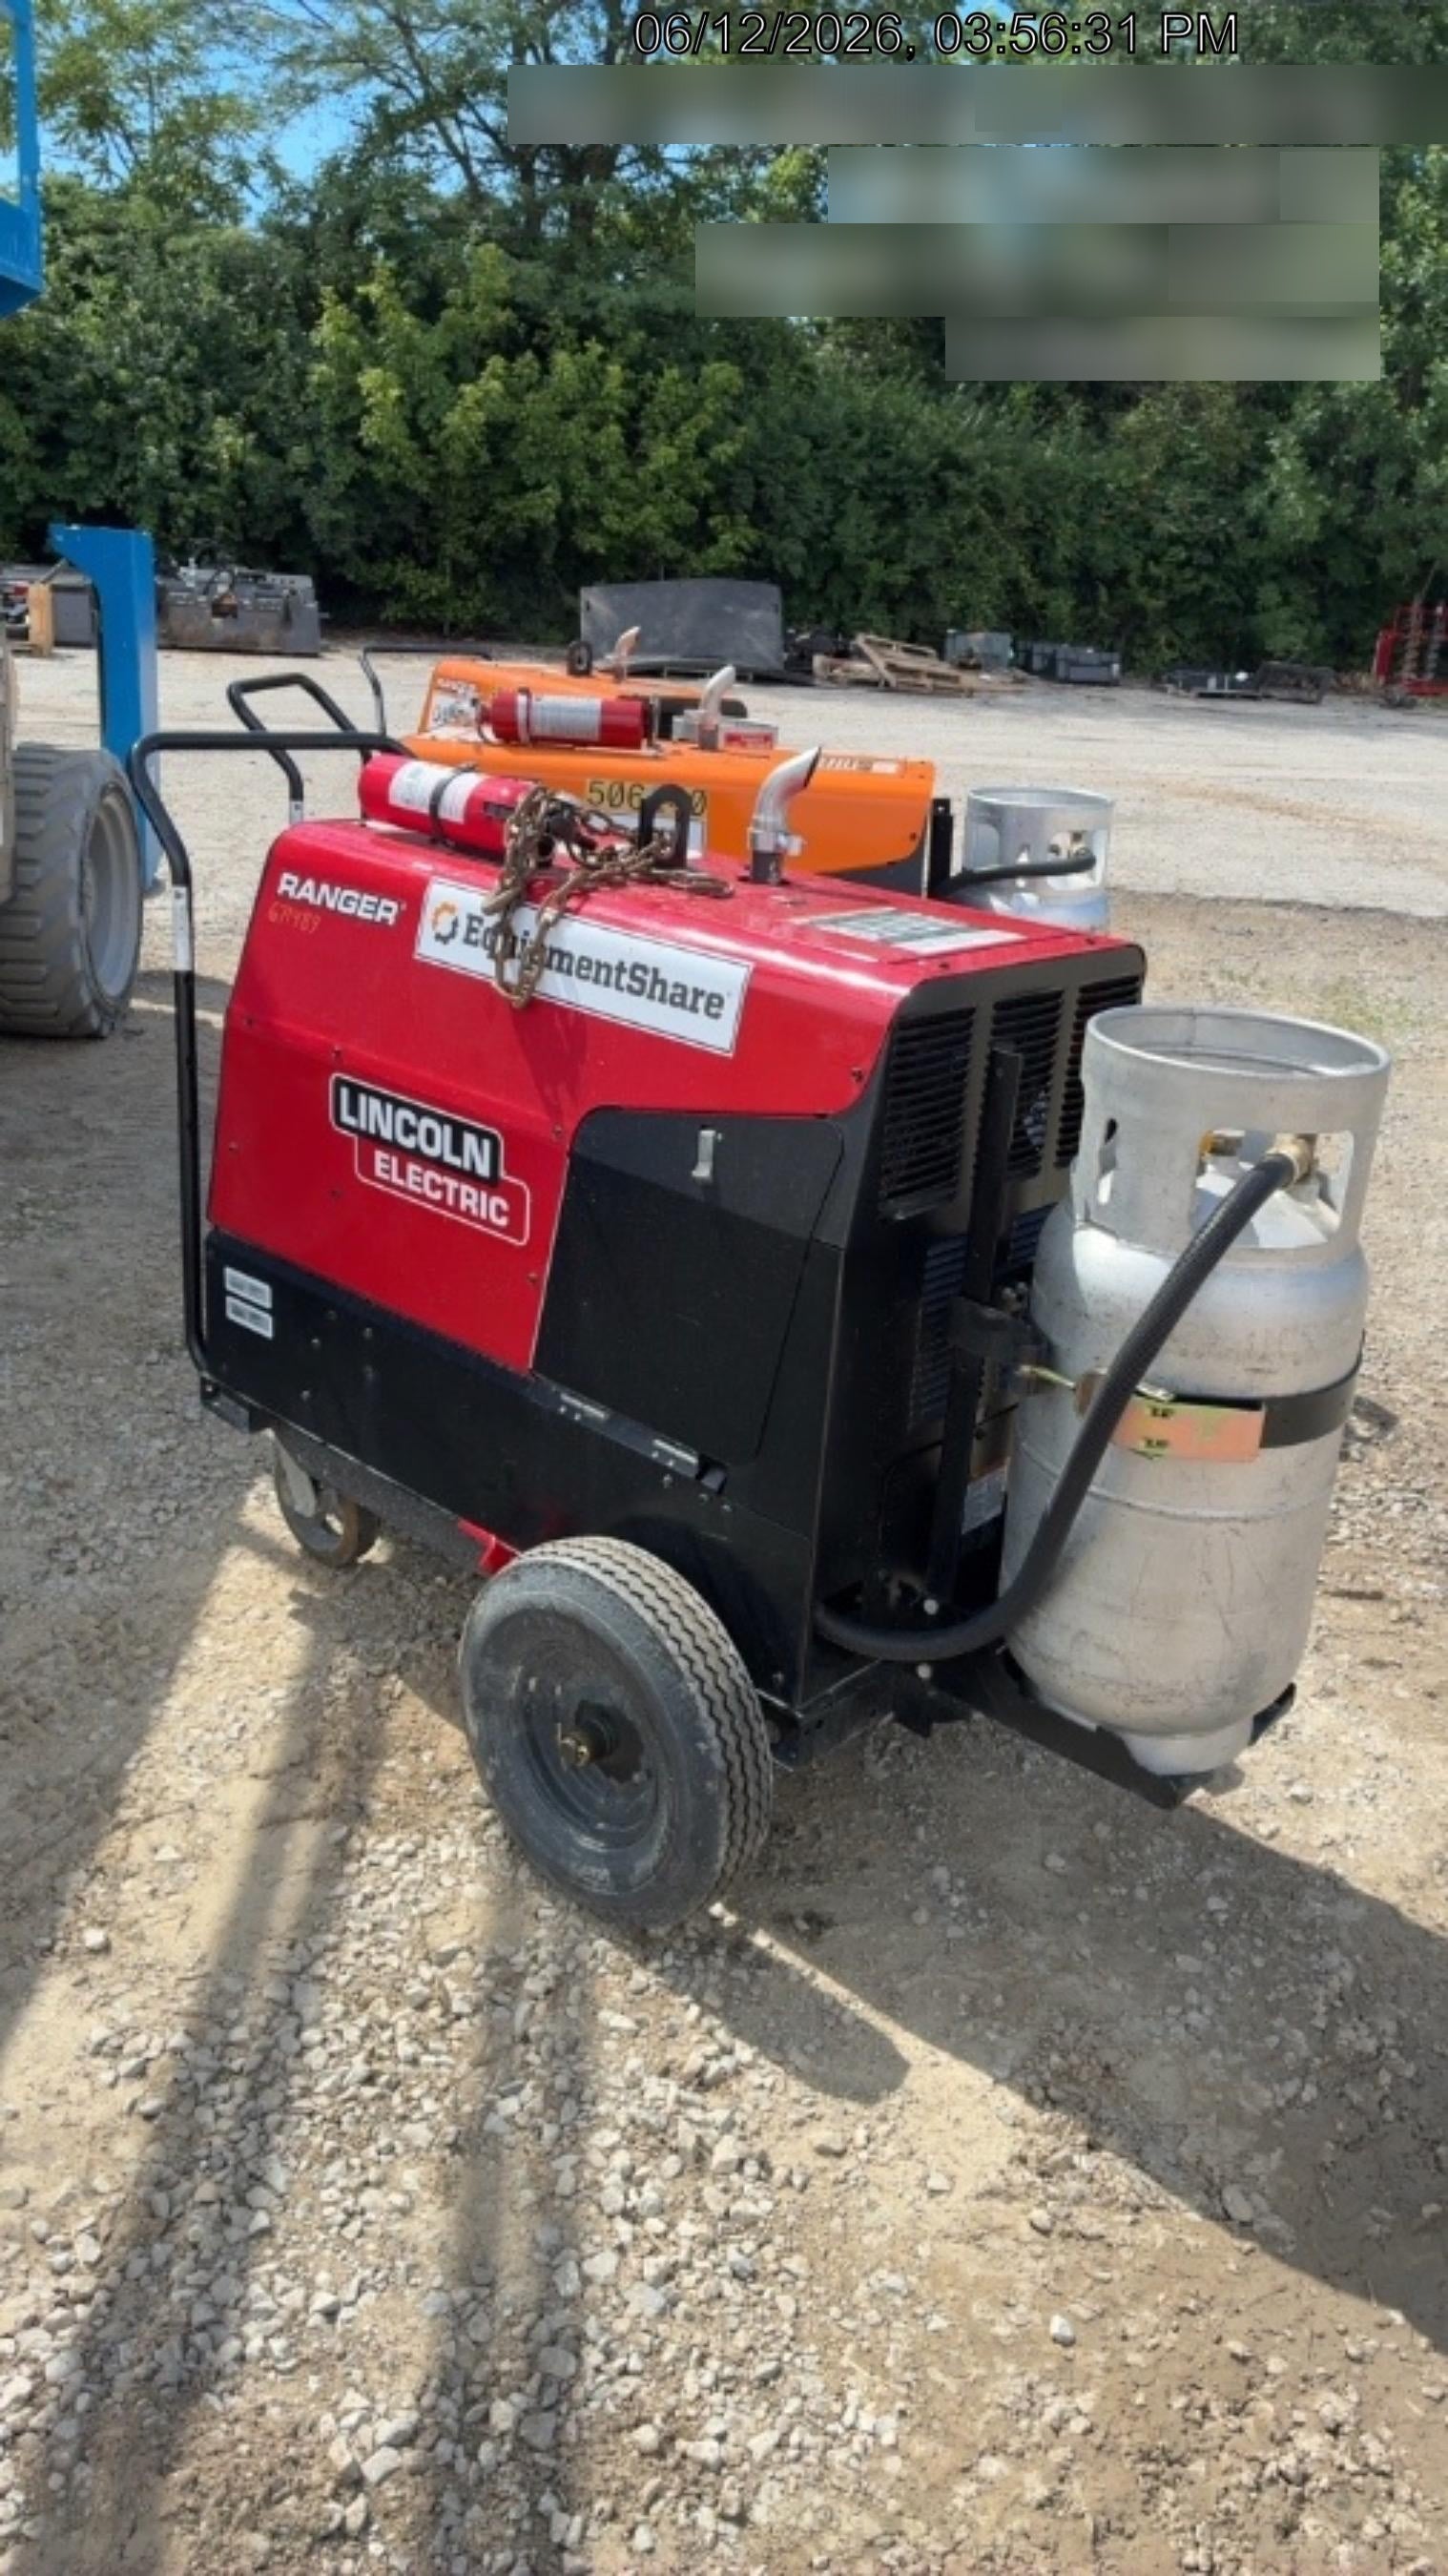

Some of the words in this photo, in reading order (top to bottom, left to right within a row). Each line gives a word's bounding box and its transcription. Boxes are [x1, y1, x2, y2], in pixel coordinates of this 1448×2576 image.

[588, 780, 708, 817] 5060
[278, 871, 399, 926] RANGER
[463, 913, 726, 1020] EquimentShare
[339, 1086, 491, 1179] LINCOLN
[374, 1149, 510, 1228] ELECTRIC
